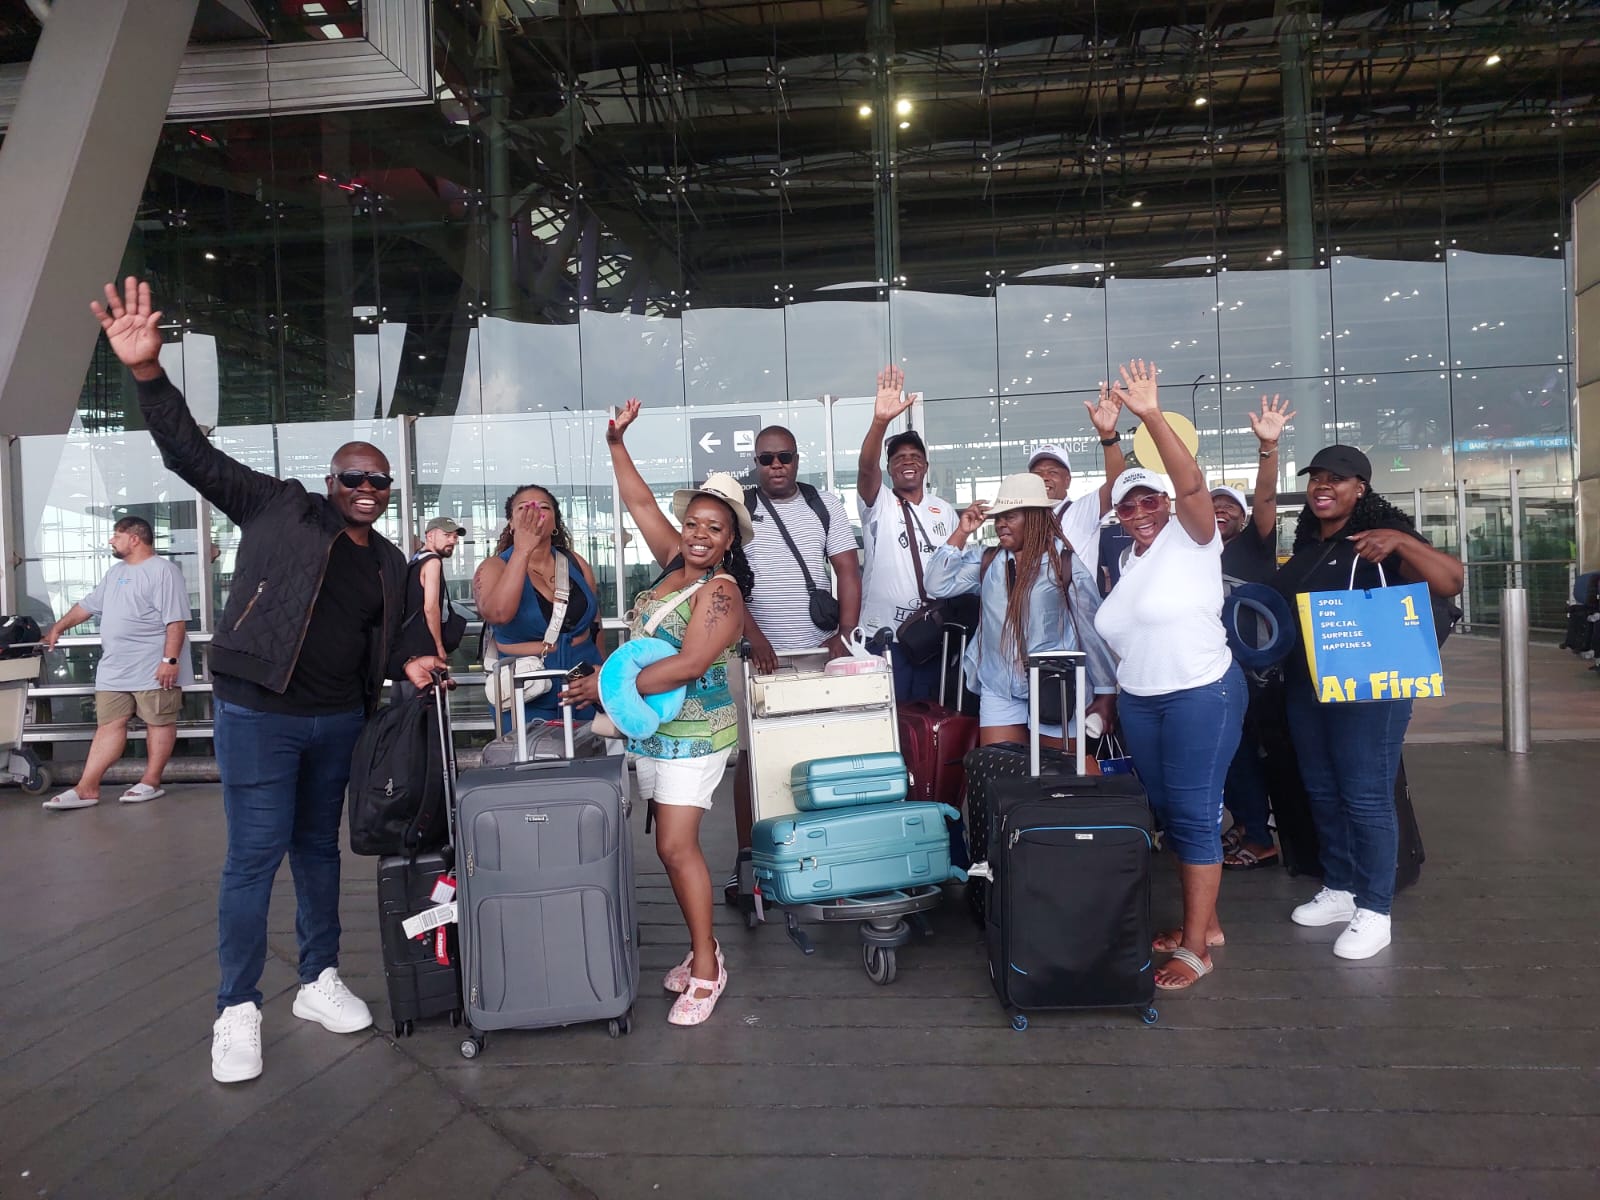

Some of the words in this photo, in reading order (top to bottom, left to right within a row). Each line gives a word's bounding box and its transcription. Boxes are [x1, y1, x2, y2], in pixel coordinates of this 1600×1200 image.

[1023, 441, 1089, 455] ENNCE
[1401, 595, 1419, 621] 1
[1320, 620, 1358, 628] SPECIAL
[1321, 630, 1364, 639] SURPRISE
[1322, 641, 1372, 650] HAPPINESS
[1320, 676, 1357, 703] At
[1369, 671, 1443, 700] First
